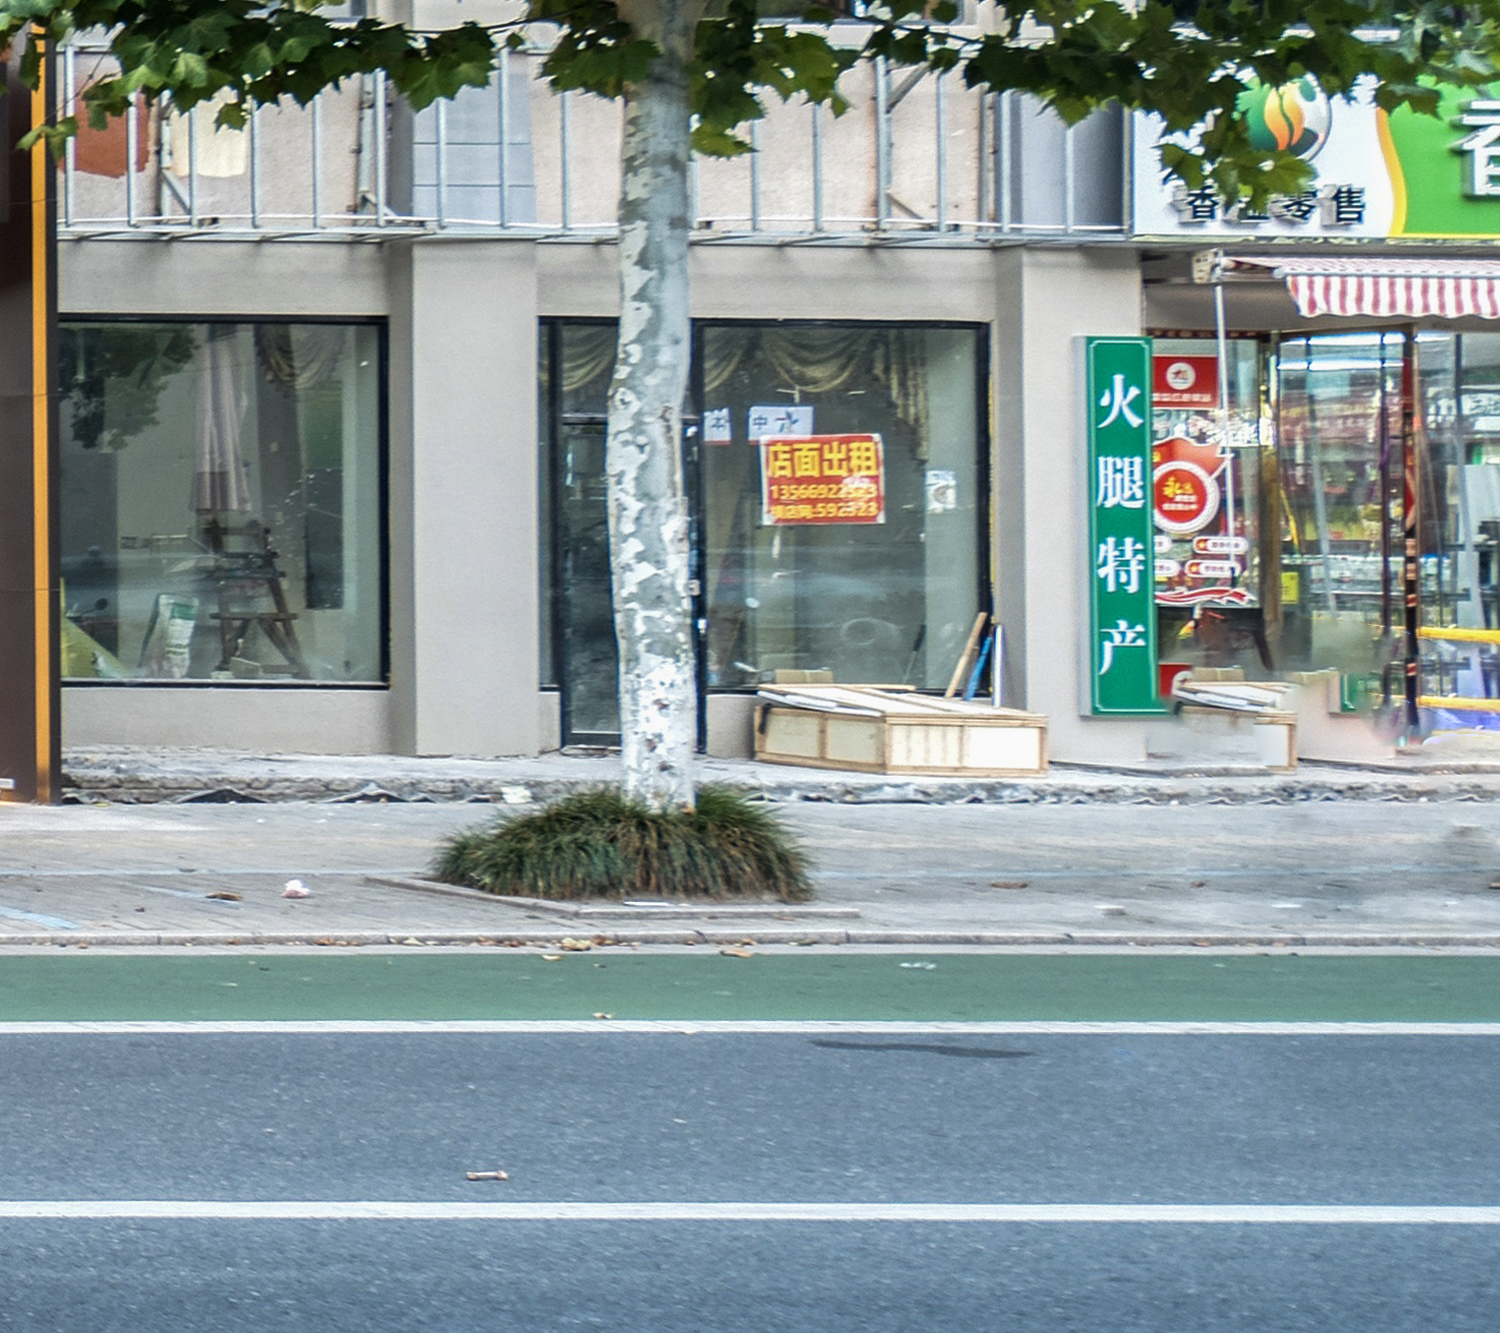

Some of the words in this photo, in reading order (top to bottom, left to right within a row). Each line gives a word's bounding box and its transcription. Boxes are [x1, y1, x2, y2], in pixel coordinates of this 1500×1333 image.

[768, 440, 879, 478] 店面出租
[1096, 373, 1146, 676] 火腿特产
